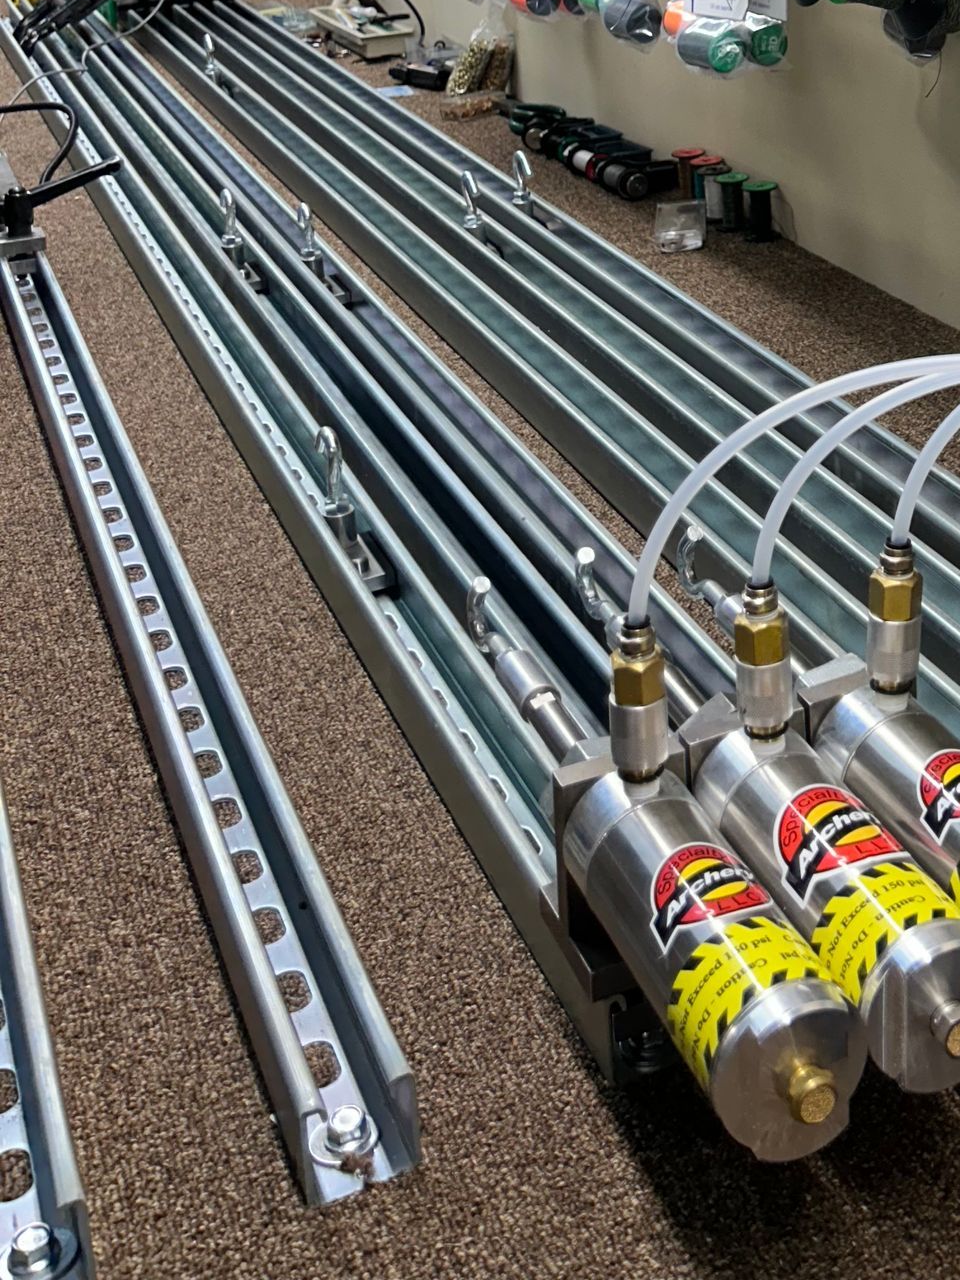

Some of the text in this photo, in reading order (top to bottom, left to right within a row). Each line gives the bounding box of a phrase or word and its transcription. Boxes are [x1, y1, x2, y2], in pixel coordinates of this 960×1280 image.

[856, 840, 888, 855] LL
[717, 892, 762, 910] LLC
[828, 929, 843, 957] Not
[843, 890, 880, 926] Exceed
[881, 880, 905, 894] 150
[839, 894, 926, 981] Caution Do Not
[688, 960, 722, 1006] Exceed
[752, 934, 772, 949] psi
[697, 1010, 711, 1030] Do
